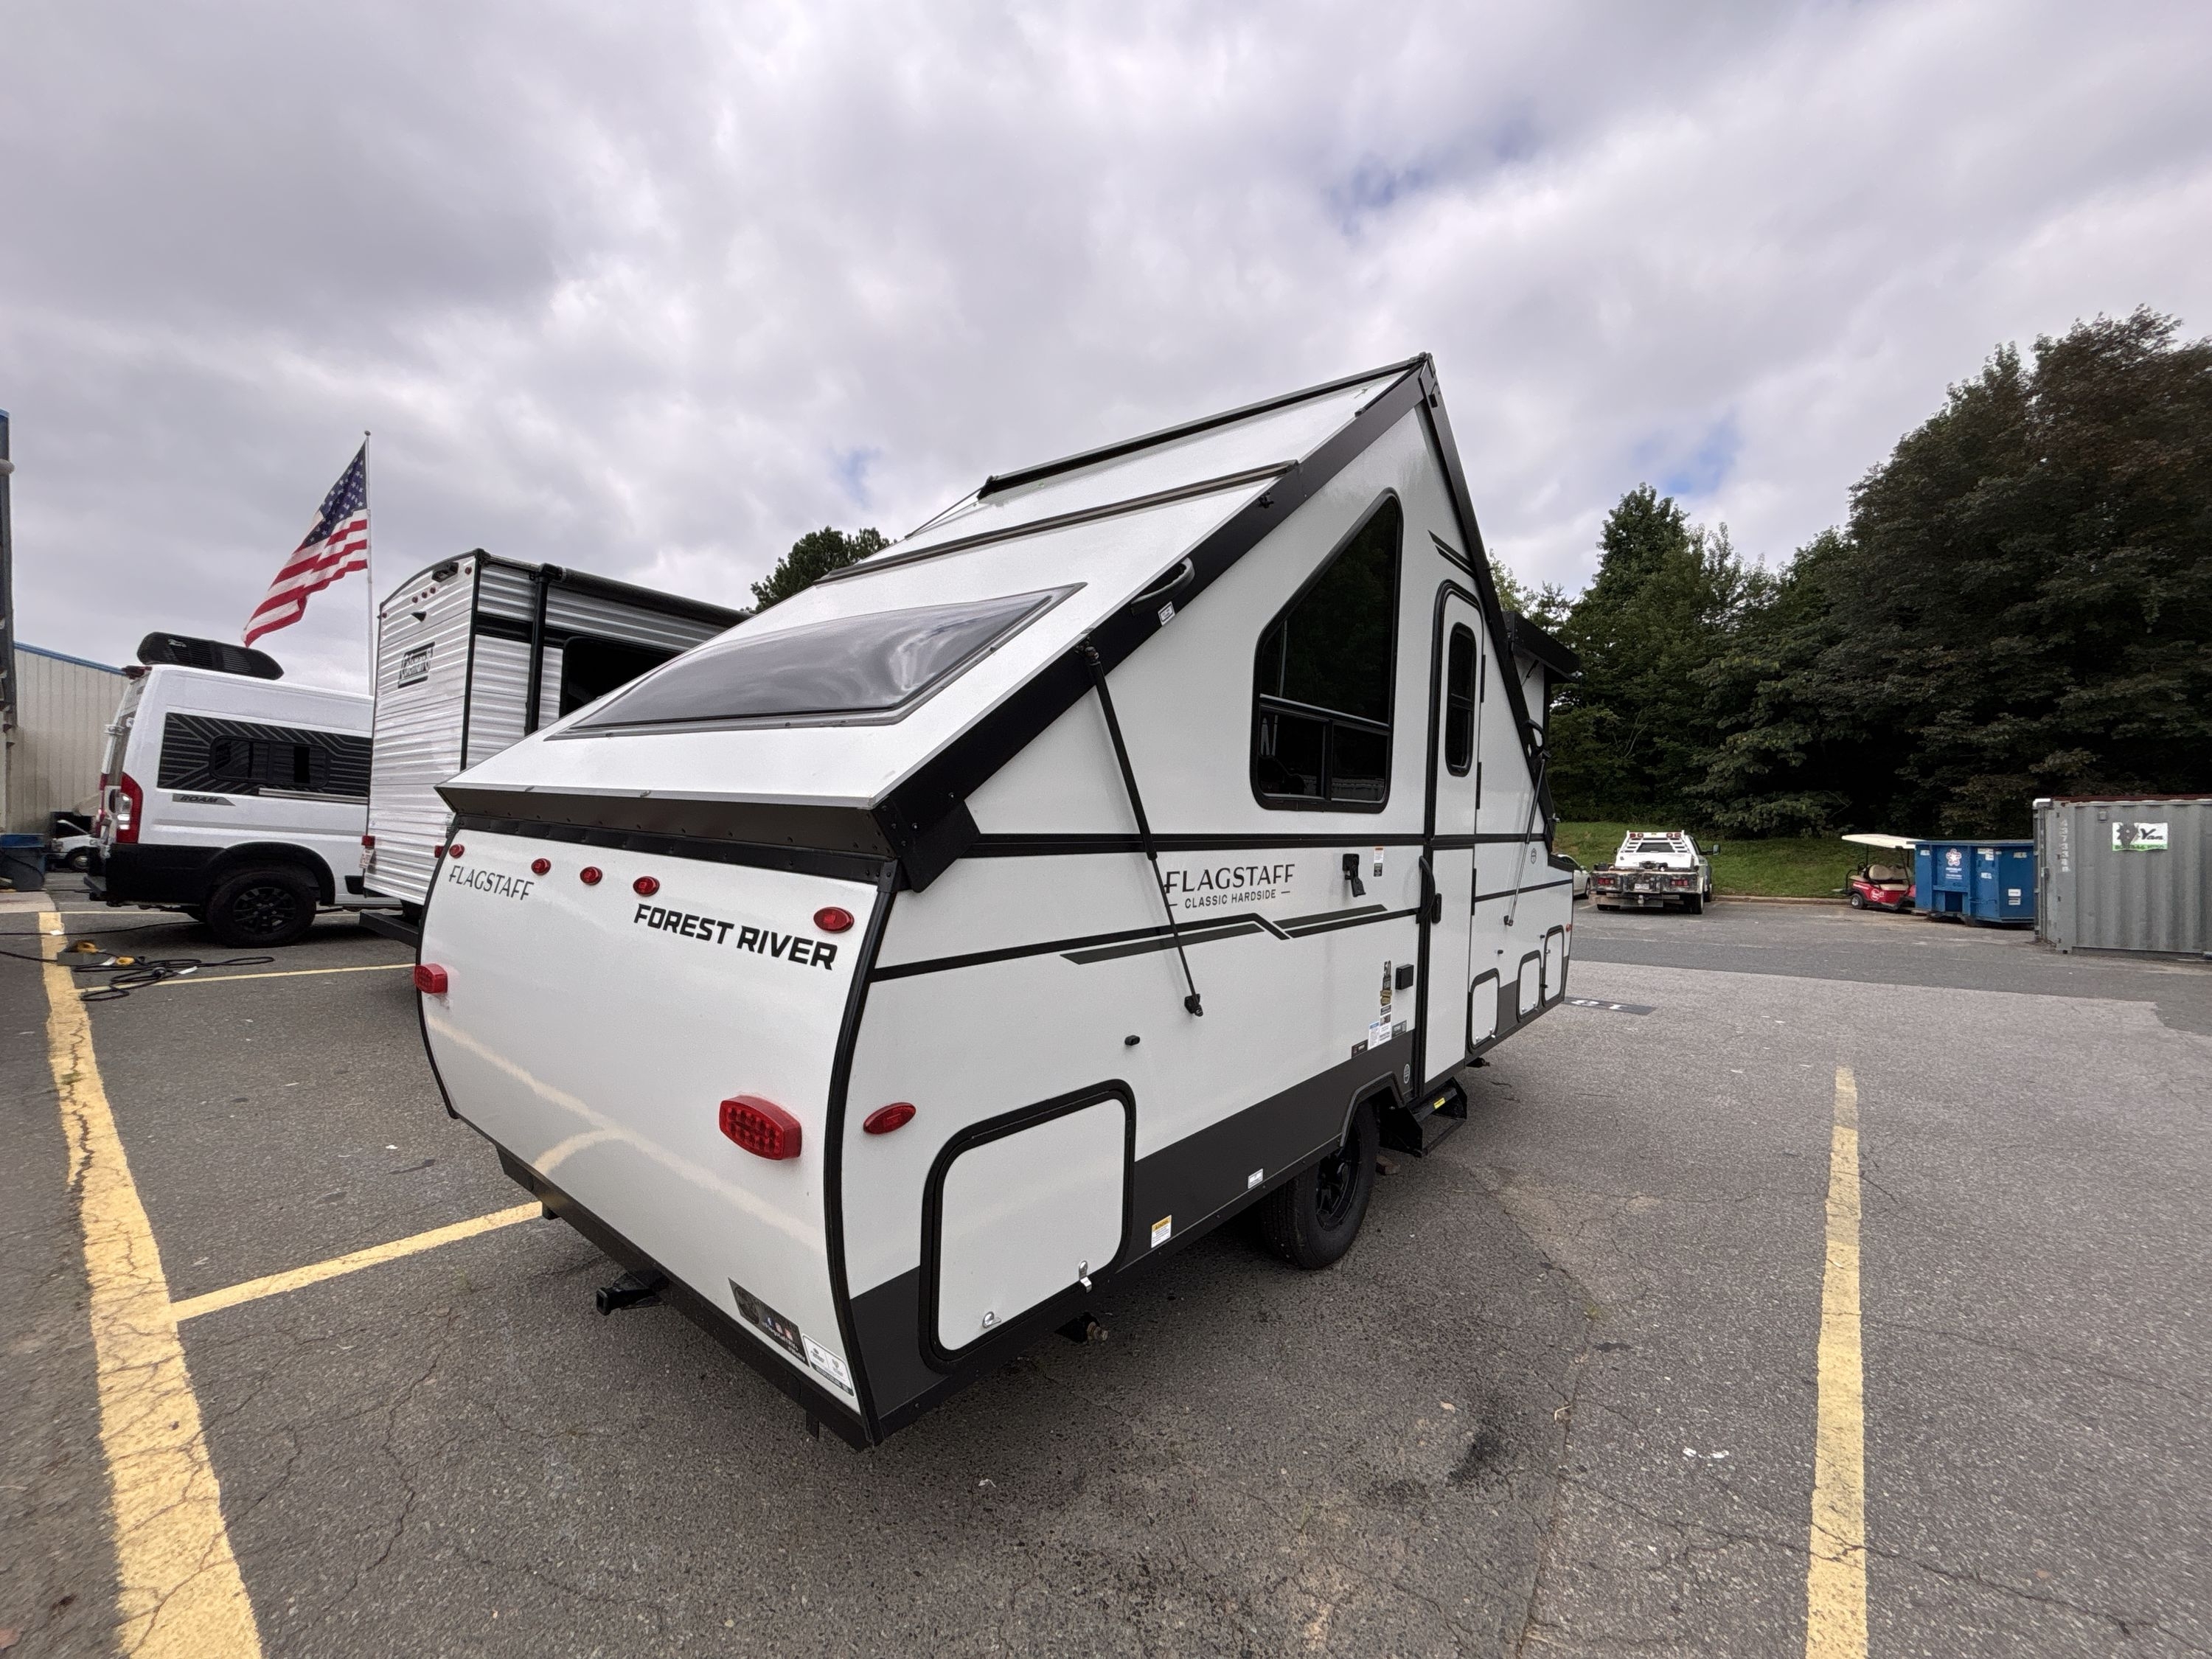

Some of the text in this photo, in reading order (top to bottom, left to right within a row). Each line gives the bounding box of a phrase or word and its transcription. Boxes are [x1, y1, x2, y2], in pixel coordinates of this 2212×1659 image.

[180, 795, 219, 804] ROAM
[448, 865, 535, 900] FLAGSTAFF
[1164, 864, 1295, 894] FLAGSTAFF
[1184, 888, 1276, 909] CLASSIC HARDSIDE
[633, 903, 838, 970] FOREST RIVER
